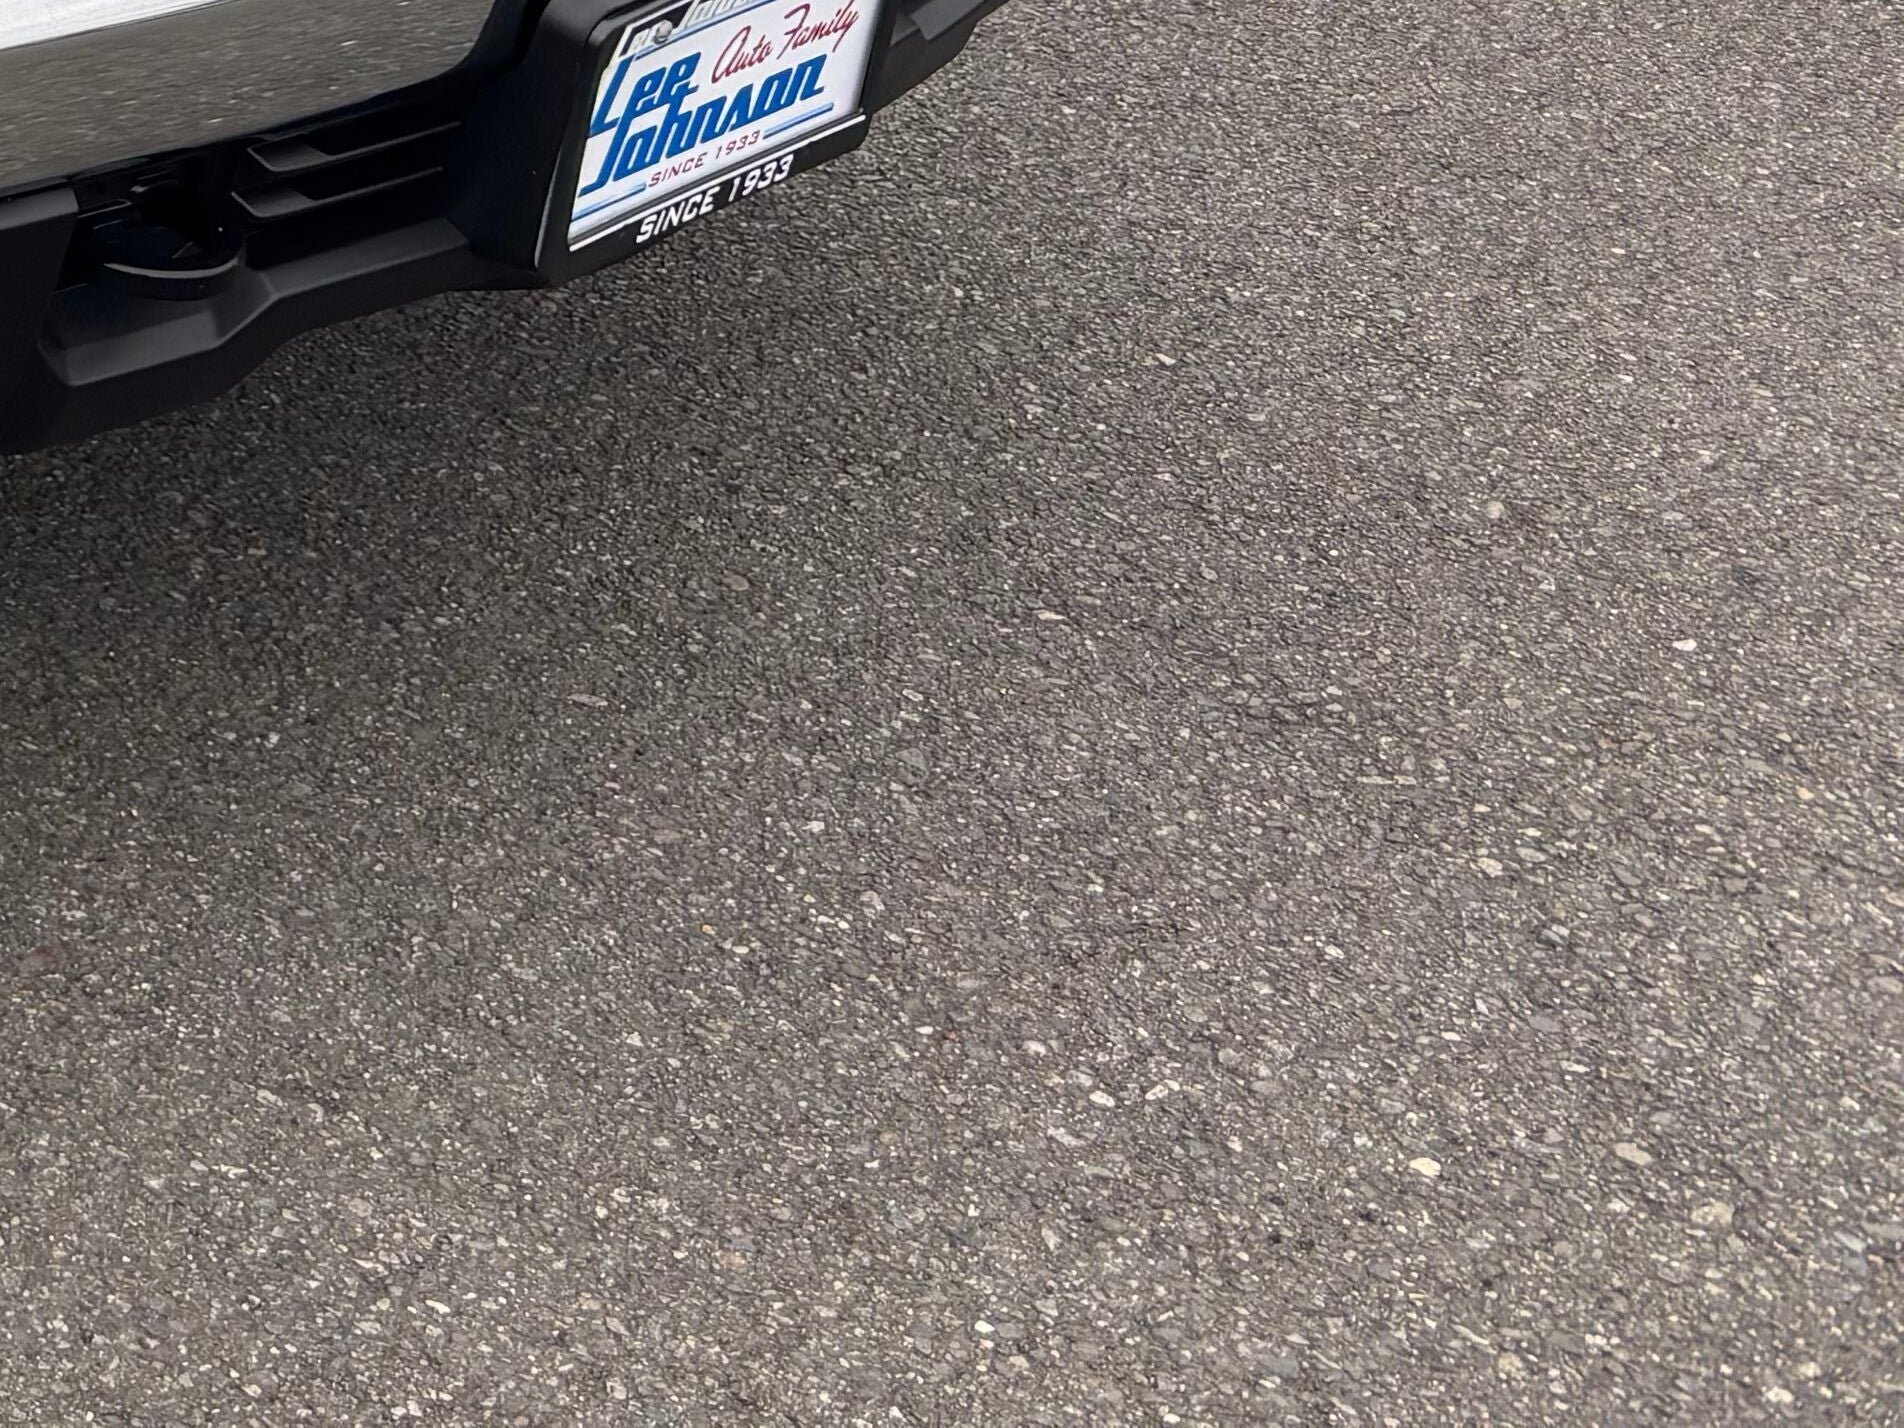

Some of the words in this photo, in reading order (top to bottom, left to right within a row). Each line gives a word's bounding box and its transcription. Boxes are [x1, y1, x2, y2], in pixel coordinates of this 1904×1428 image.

[588, 52, 702, 138] Lee
[711, 25, 774, 84] Auto
[577, 53, 828, 199] Johnson
[647, 152, 707, 188] SINCE
[715, 130, 761, 161] 1933
[635, 186, 721, 244] SINCE
[728, 154, 794, 203] 1933
